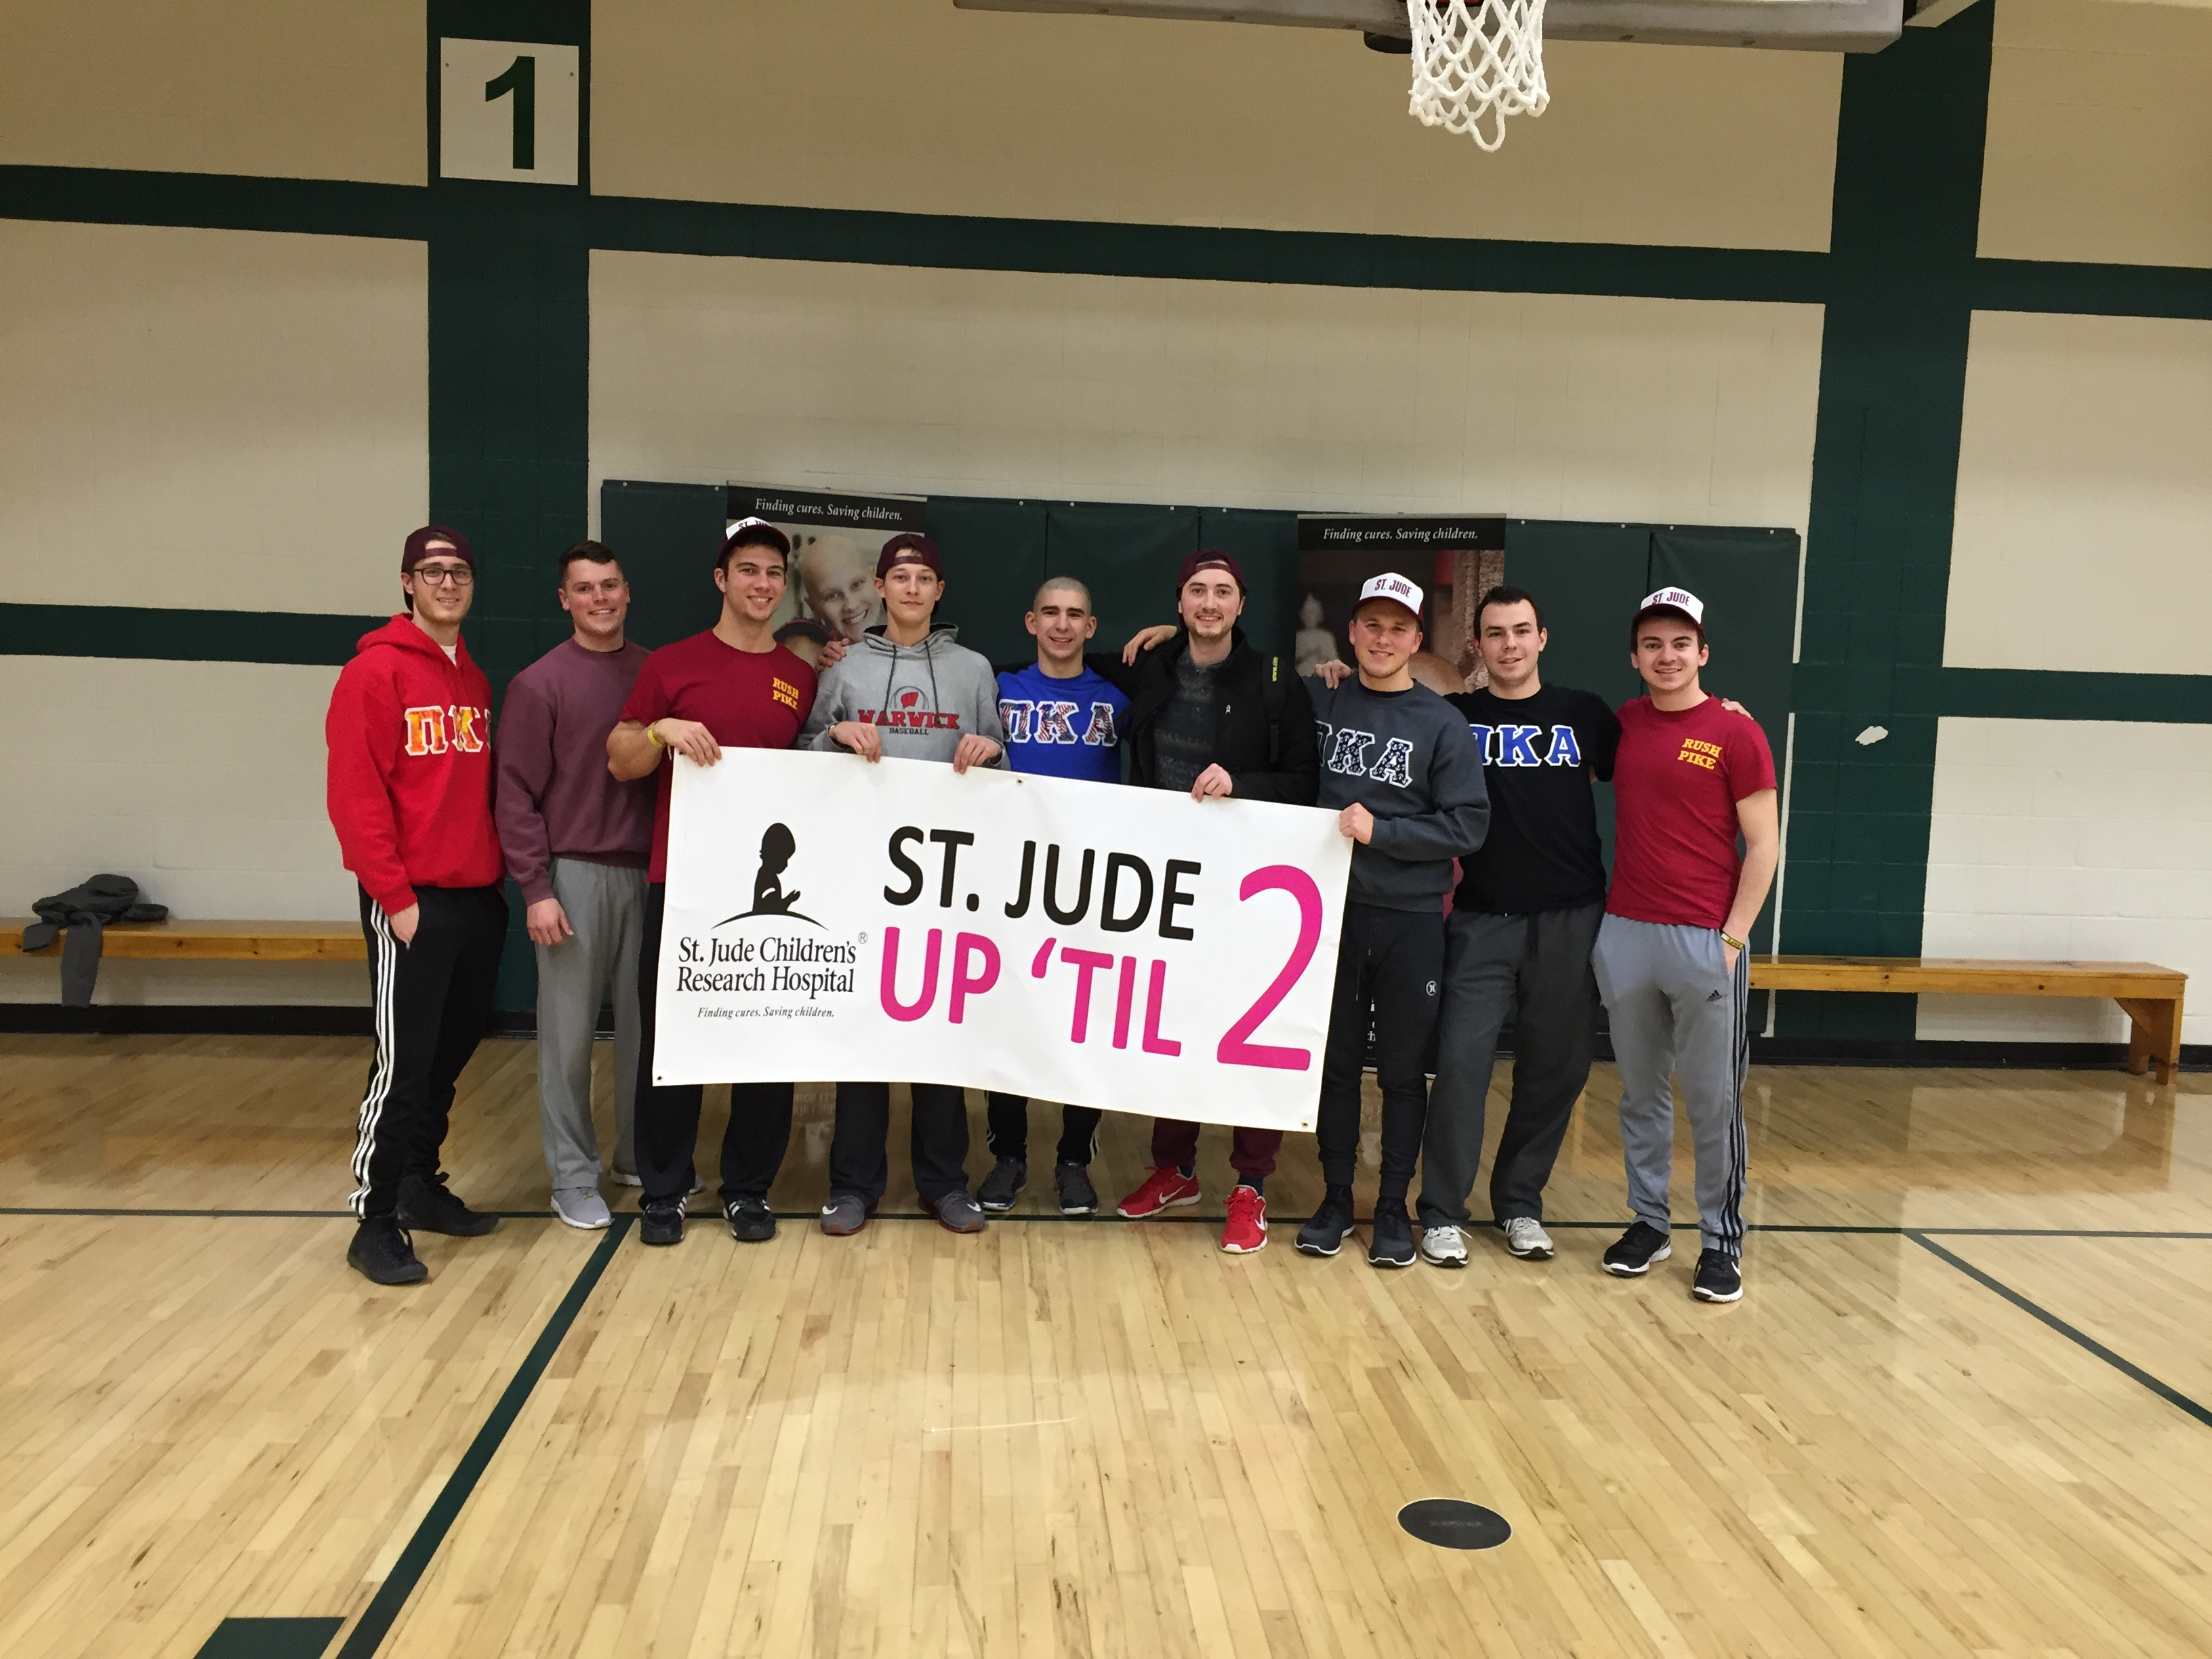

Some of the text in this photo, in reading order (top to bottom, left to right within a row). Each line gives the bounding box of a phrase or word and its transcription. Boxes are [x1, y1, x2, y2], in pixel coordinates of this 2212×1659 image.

[485, 56, 535, 169] 1
[755, 498, 903, 520] Finding cures. Saving children.
[1323, 527, 1478, 542] Finding cures. Saving children.
[1389, 579, 1412, 598] JUDE
[1666, 592, 1691, 606] JUDE
[773, 677, 799, 699] RUSH
[857, 709, 960, 730] WARWICK
[888, 727, 929, 736] BASEBALL
[1682, 738, 1722, 758] RUSH
[1677, 750, 1716, 770] PIKE
[883, 825, 1202, 941] ST. JUDE
[678, 937, 704, 962] St.
[708, 937, 755, 967] Jude
[759, 937, 857, 964] Children's
[880, 864, 1324, 1071] UP 'TIL 2
[676, 966, 854, 1000] Research Hospital
[697, 1006, 835, 1020] Finding cures. Saving children.
